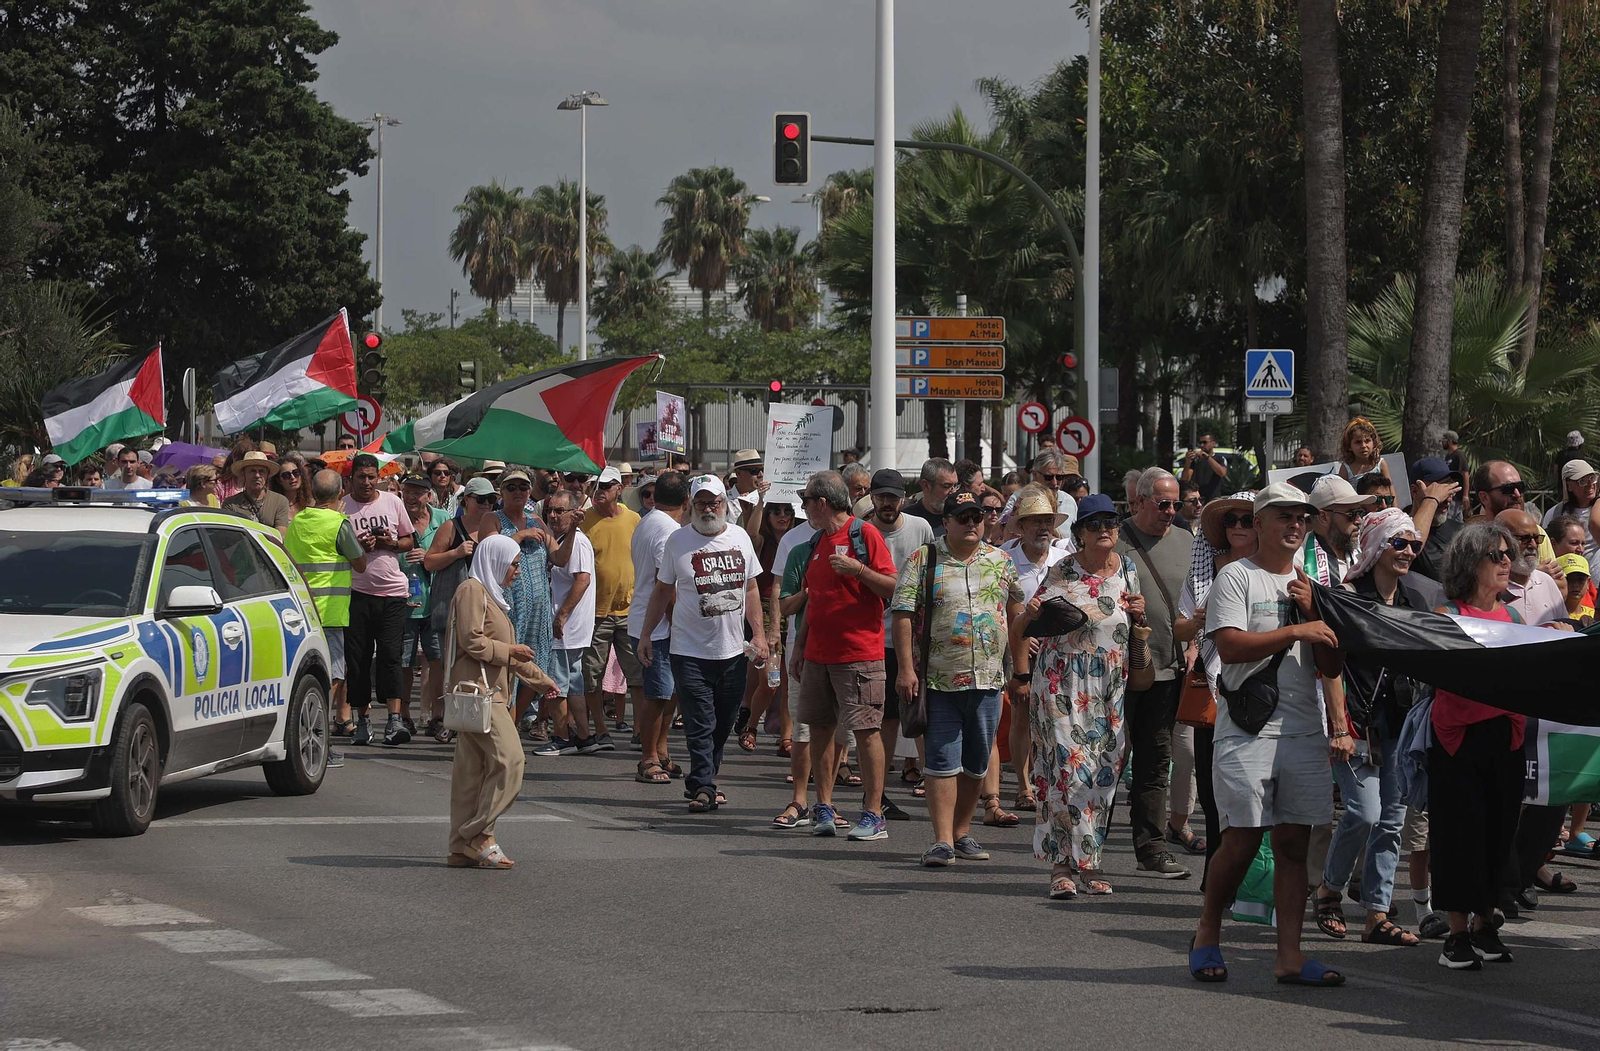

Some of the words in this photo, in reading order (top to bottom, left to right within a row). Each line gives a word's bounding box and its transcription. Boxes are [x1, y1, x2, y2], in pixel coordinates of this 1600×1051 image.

[915, 321, 927, 336] P
[976, 321, 999, 329] Hotel
[915, 350, 927, 365] P
[945, 358, 963, 366] Don
[966, 358, 1000, 367] Manuel
[914, 379, 926, 394] P
[975, 379, 999, 387] Hotel
[930, 387, 961, 395] Marina
[964, 387, 999, 396] Victoria
[354, 515, 389, 530] ICON
[702, 555, 737, 572] ISRAEL
[194, 689, 241, 720] POLICIA
[245, 682, 285, 711] LOCAL
